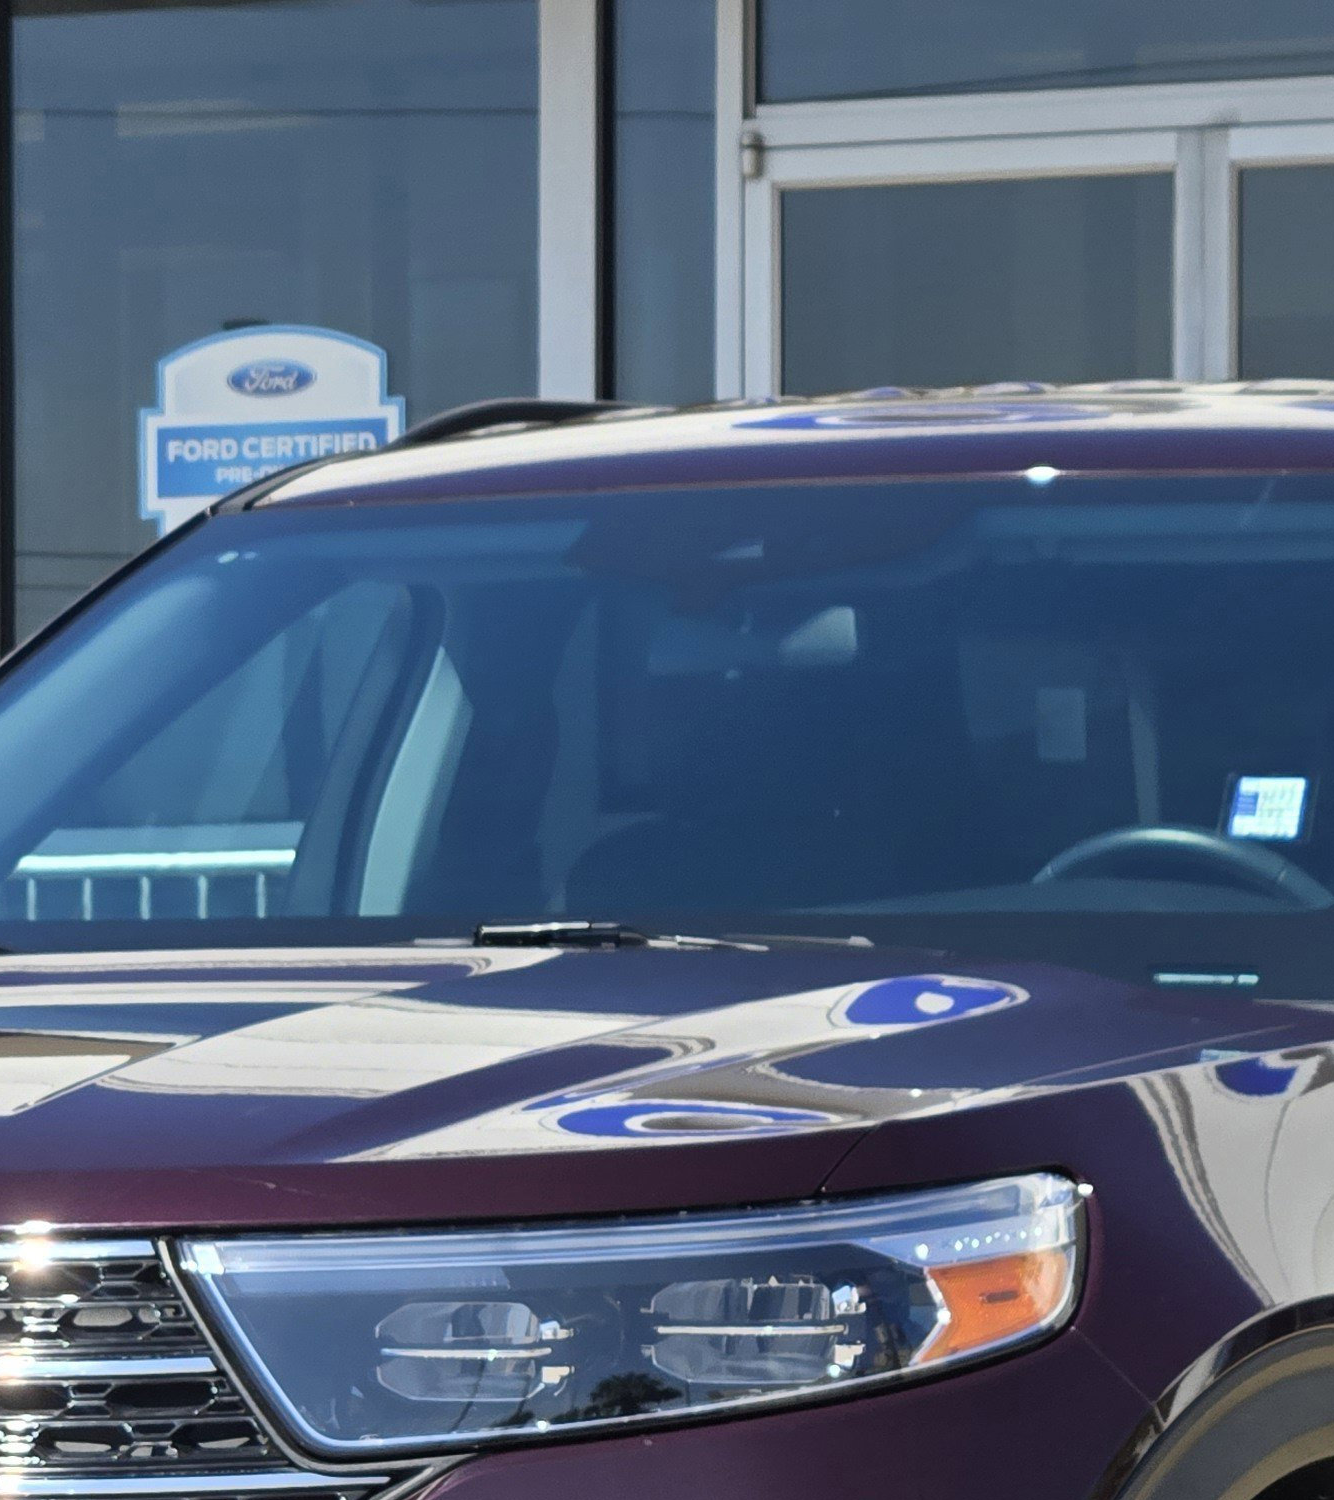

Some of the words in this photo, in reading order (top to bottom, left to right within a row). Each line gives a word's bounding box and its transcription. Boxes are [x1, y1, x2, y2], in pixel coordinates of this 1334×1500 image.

[244, 364, 299, 392] Ford
[167, 437, 239, 463] FORD
[242, 430, 378, 460] CERTIFIED
